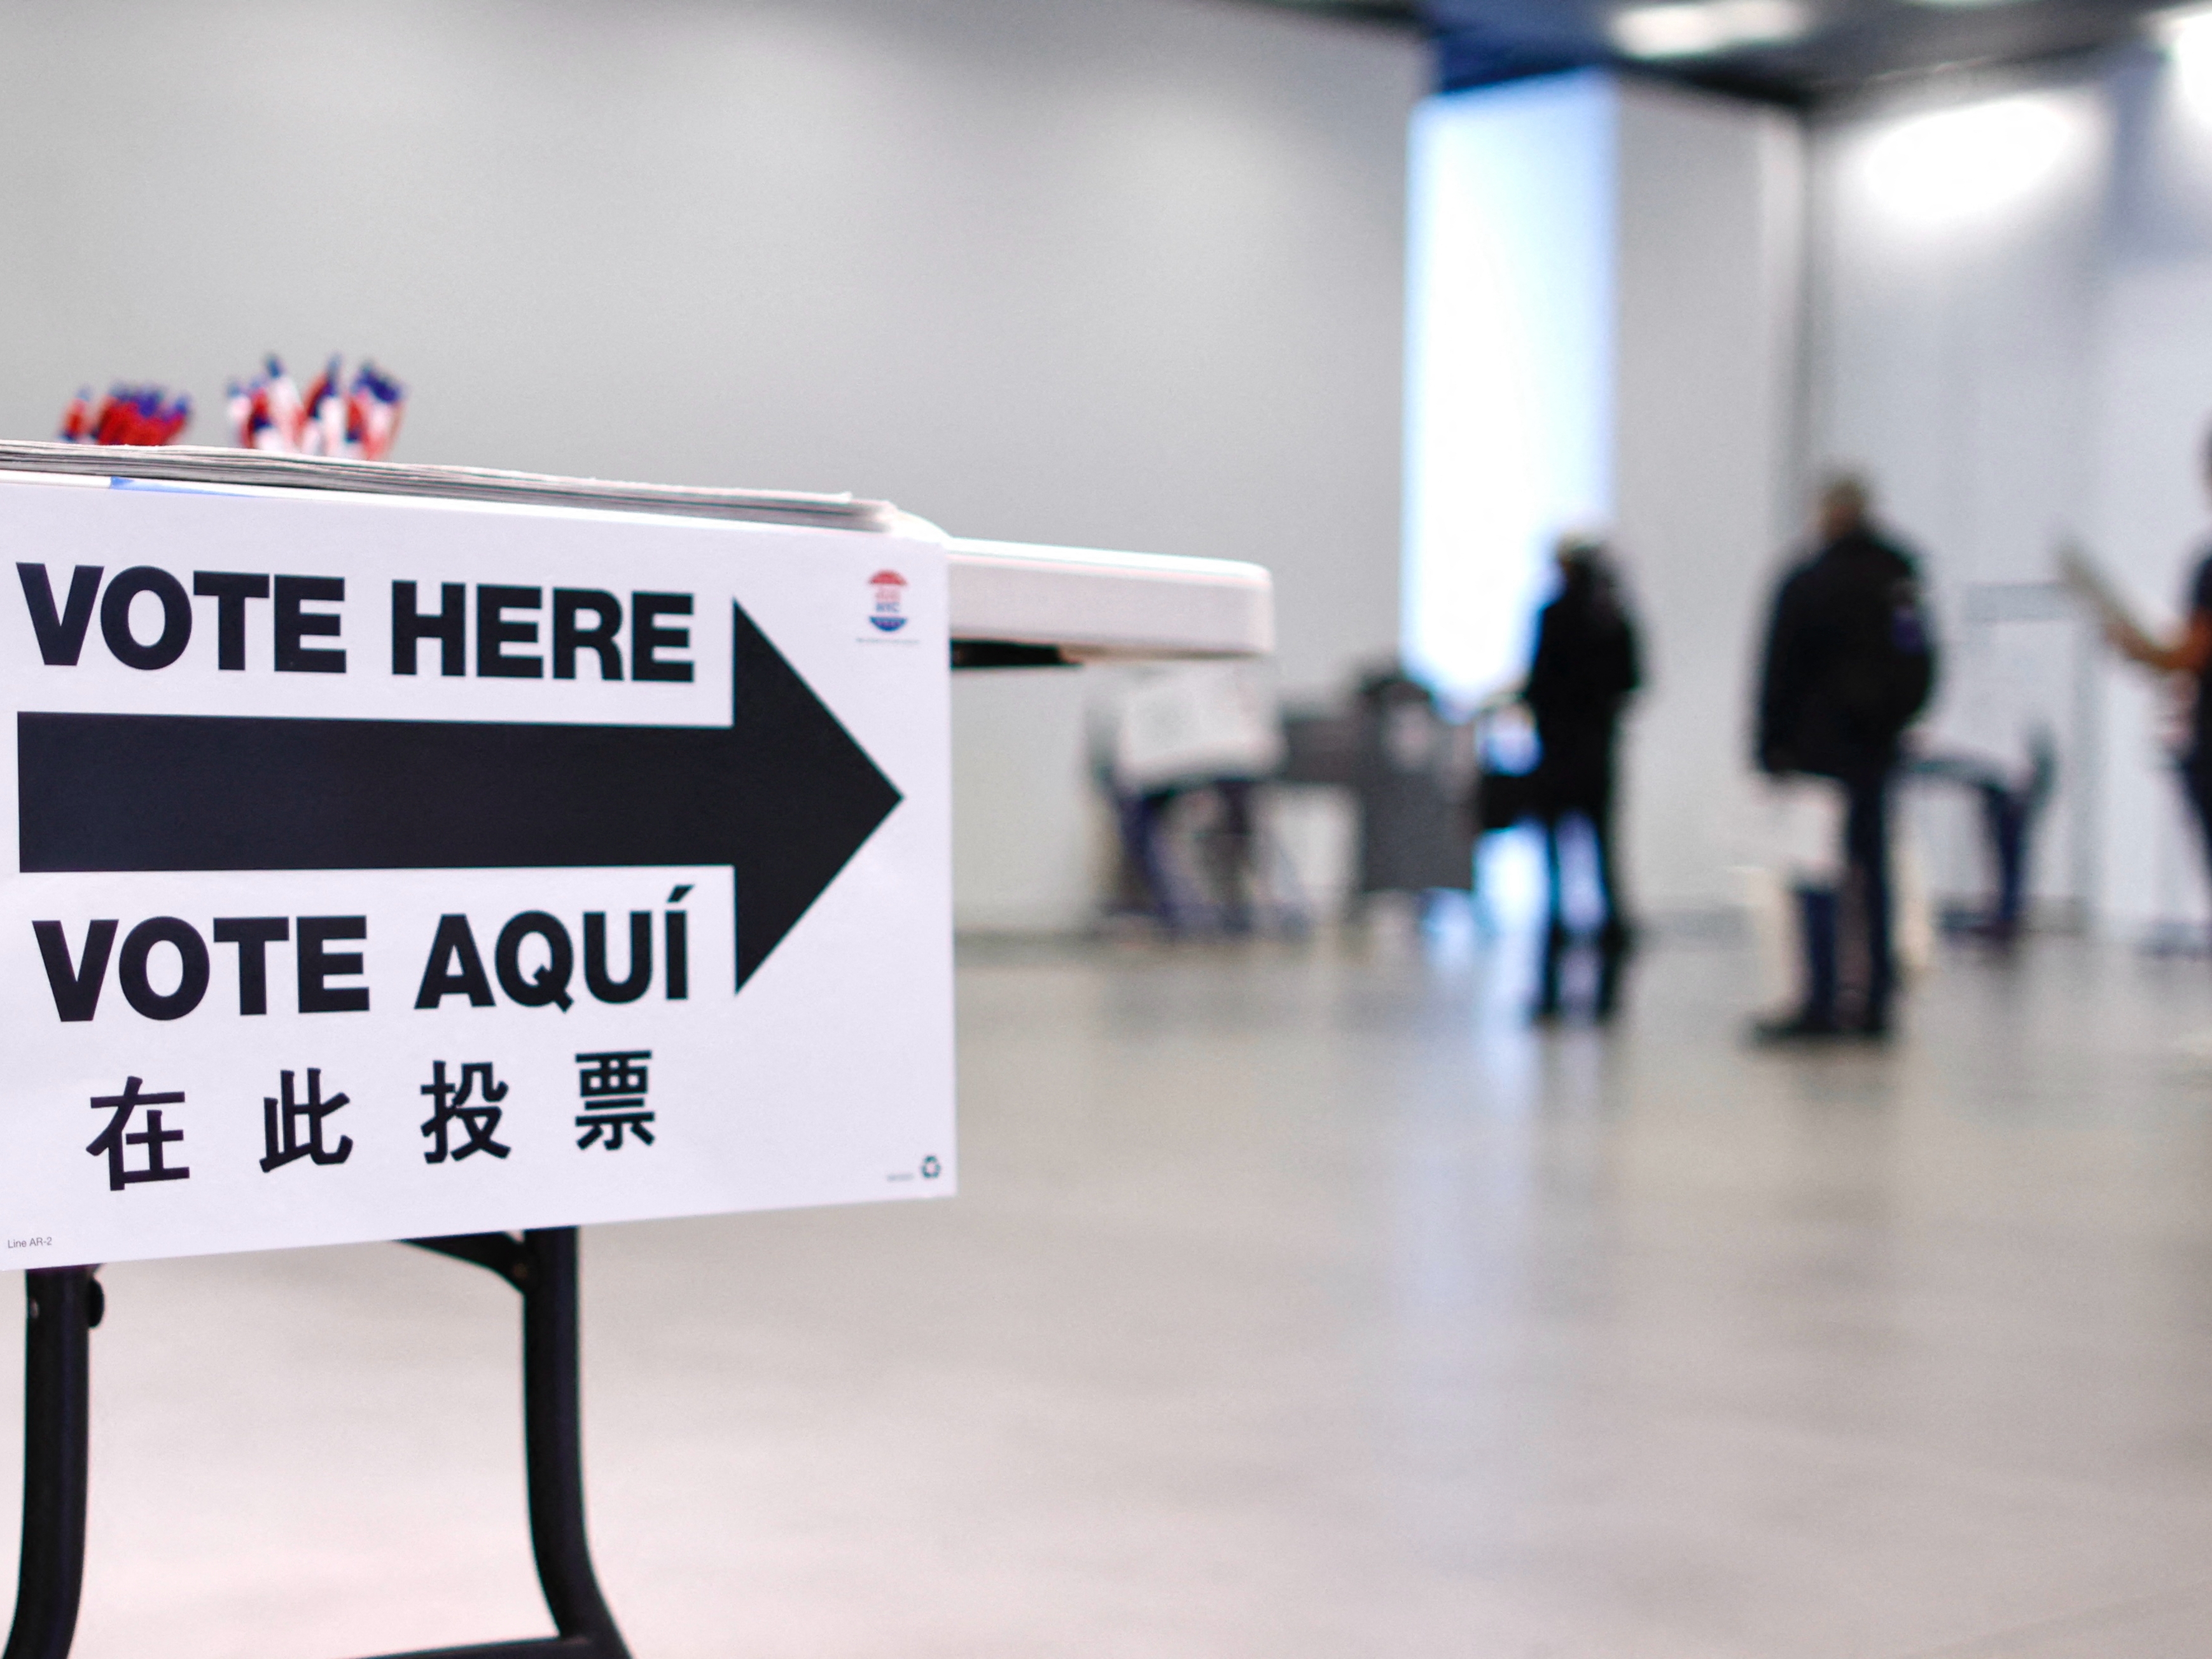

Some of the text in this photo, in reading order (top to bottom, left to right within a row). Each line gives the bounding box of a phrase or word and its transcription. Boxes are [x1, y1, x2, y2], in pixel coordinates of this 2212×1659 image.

[15, 562, 695, 683] VOTE HERE
[32, 884, 695, 1023] VOTE AQUÍ
[85, 1050, 656, 1191] 在此投票
[8, 1237, 52, 1249] Line AR-2
